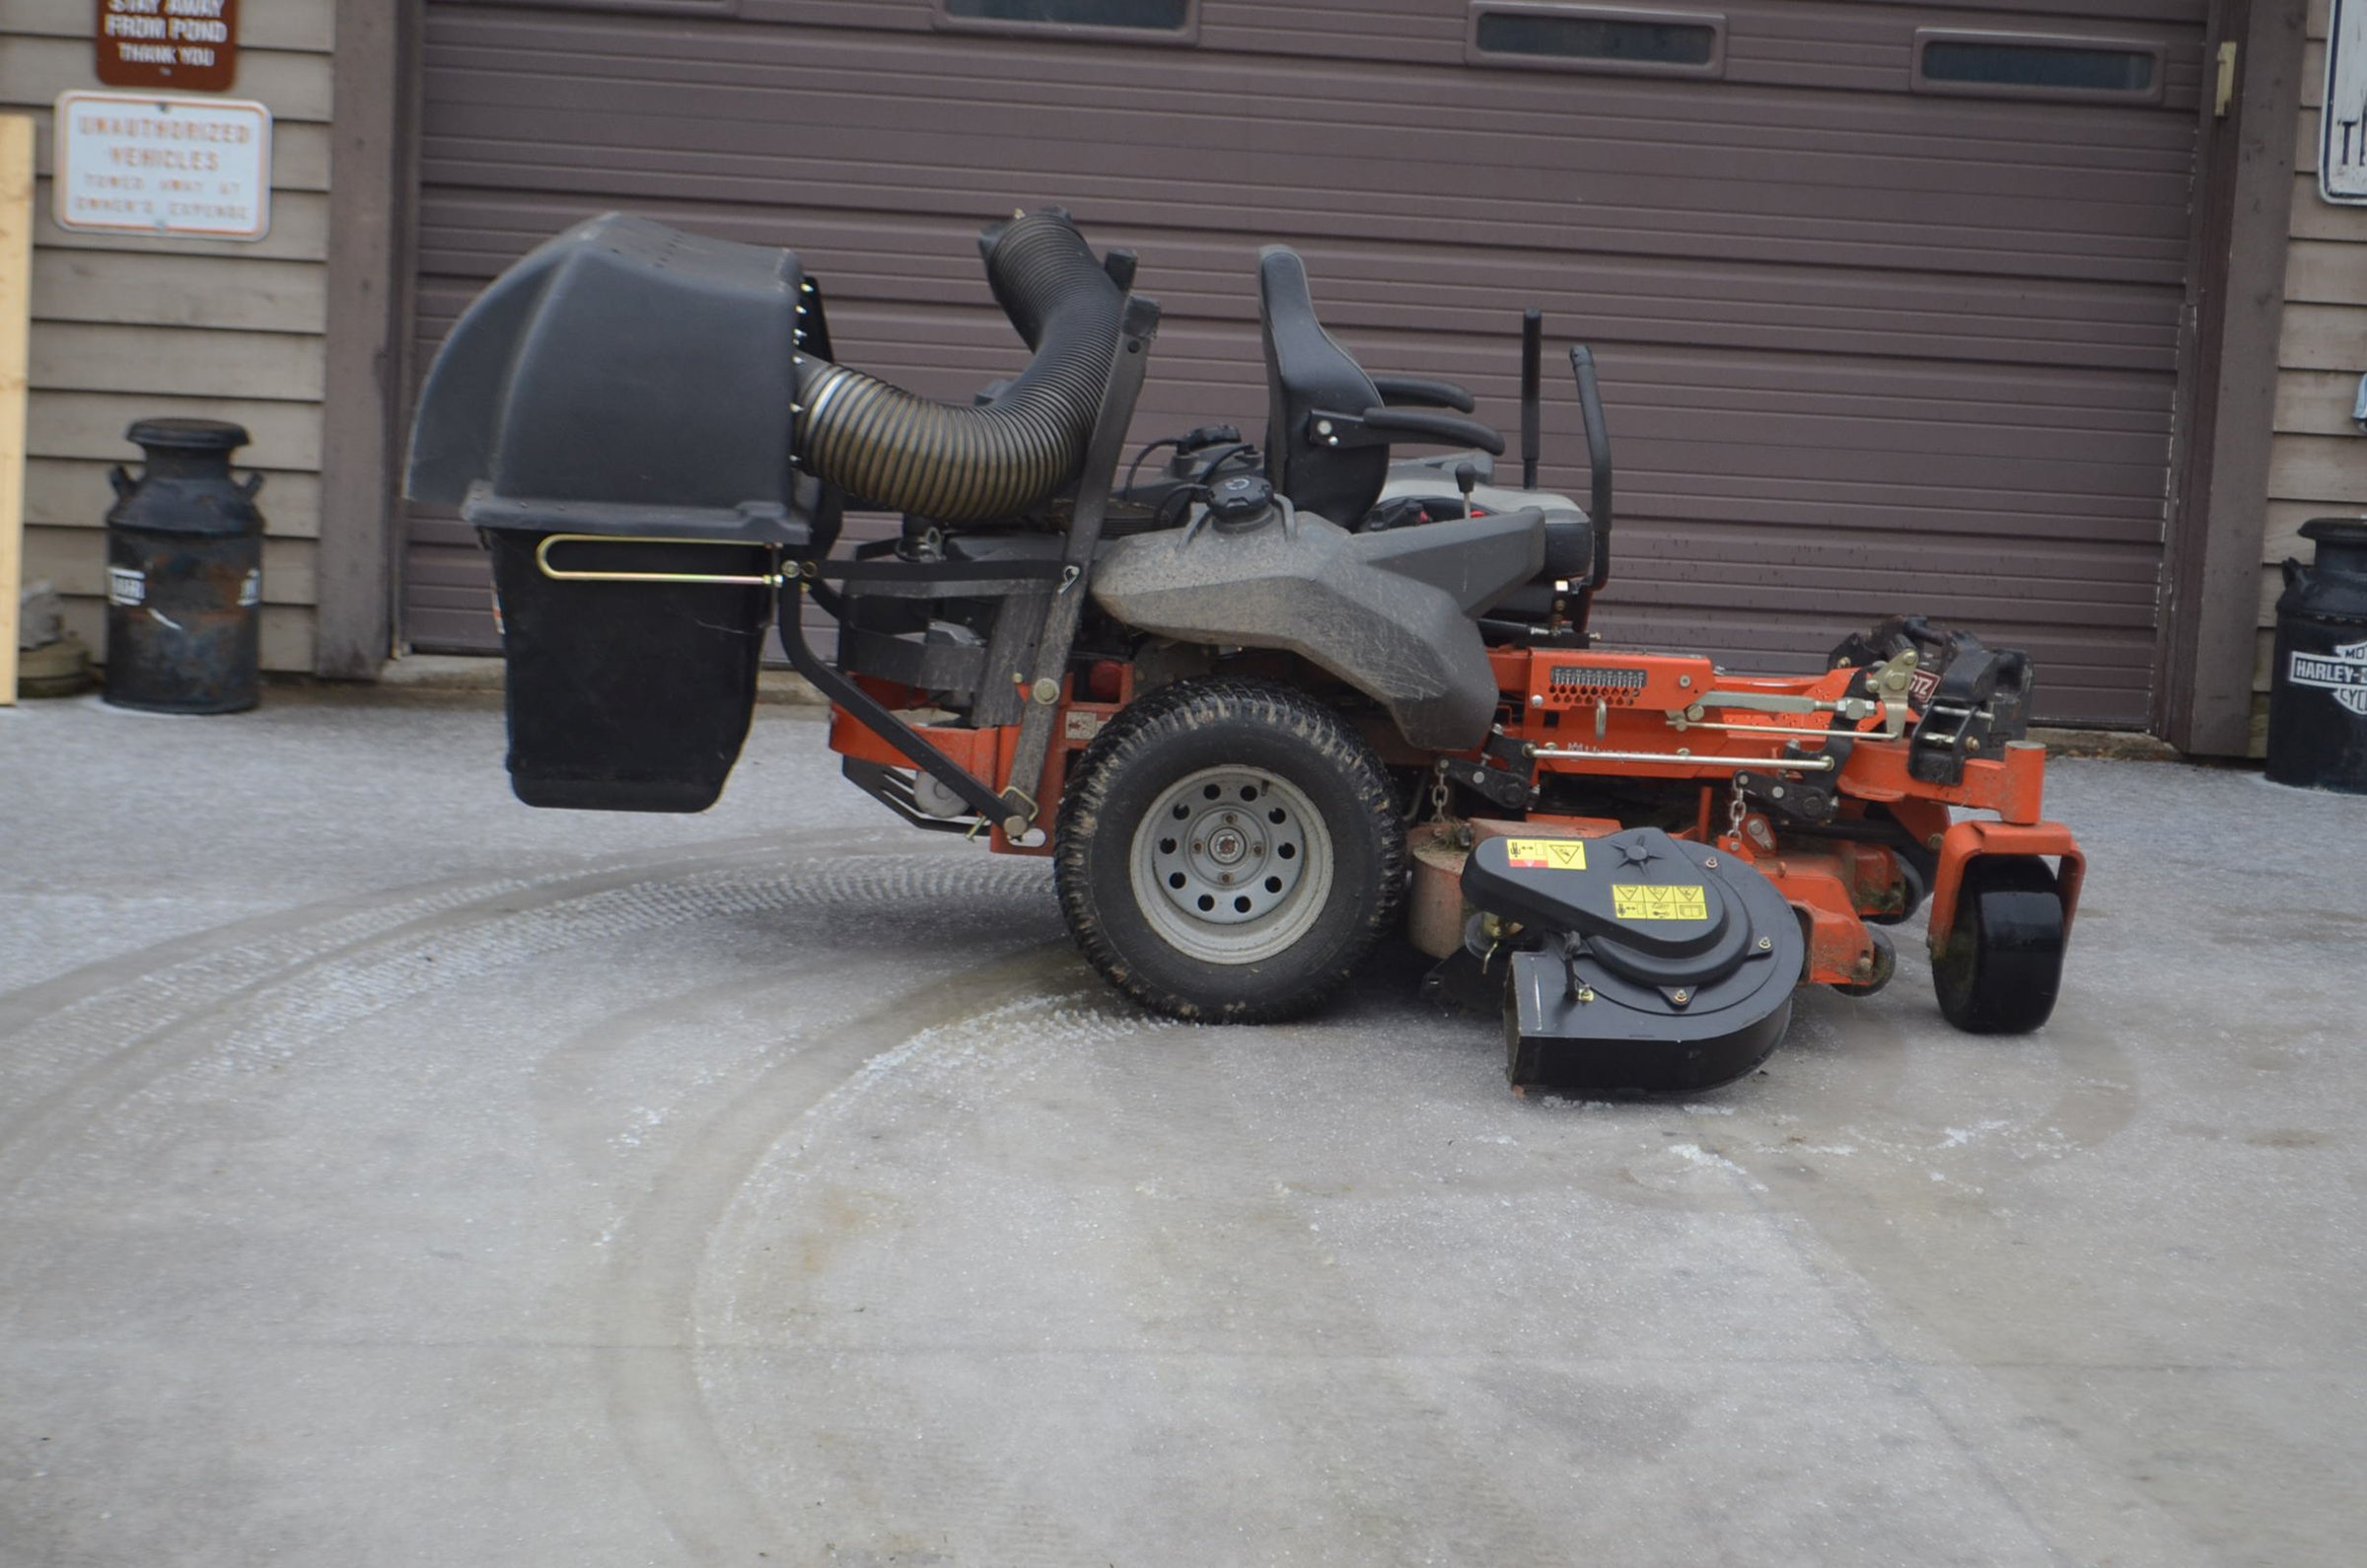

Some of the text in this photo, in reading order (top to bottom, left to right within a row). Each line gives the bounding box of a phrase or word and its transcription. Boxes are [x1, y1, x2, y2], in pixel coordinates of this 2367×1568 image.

[105, 14, 228, 42] FROM POND
[116, 41, 216, 67] THANK YOU
[79, 115, 251, 144] UNAUTHORIZED
[109, 146, 220, 172] VEHICLES
[2345, 645, 2367, 660] MO
